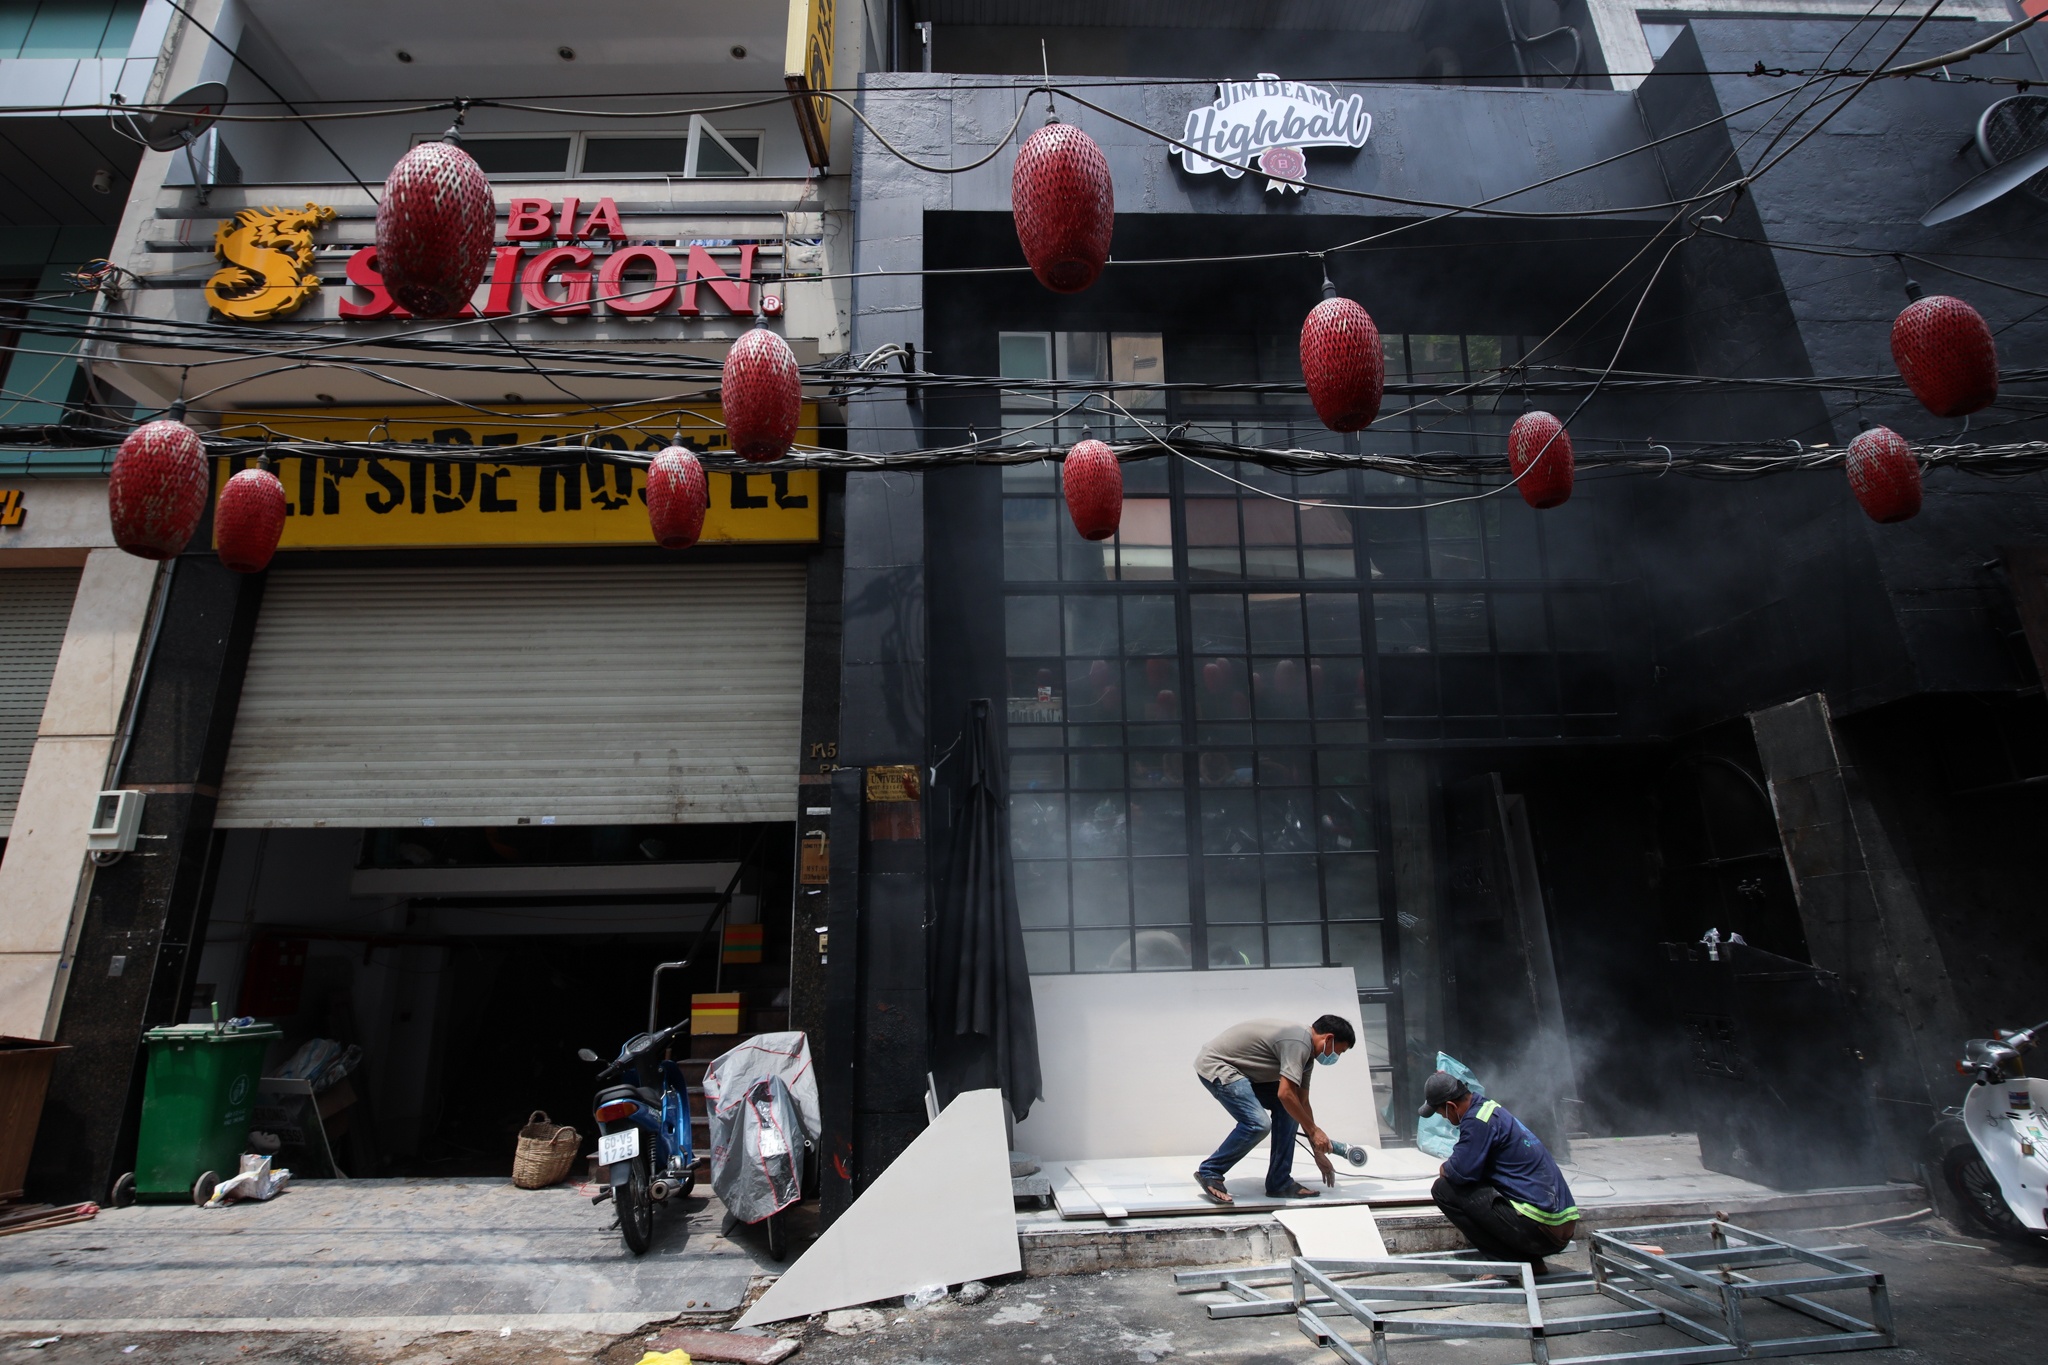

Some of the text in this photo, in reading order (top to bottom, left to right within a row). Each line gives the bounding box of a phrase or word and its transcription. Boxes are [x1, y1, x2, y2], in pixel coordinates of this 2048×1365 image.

[1216, 75, 1331, 113] JIM BEAM
[1172, 97, 1369, 177] Highball
[505, 197, 627, 241] BIA
[338, 244, 759, 320] SIGON
[604, 1132, 632, 1150] 60-V5
[604, 1144, 633, 1162] 1725
